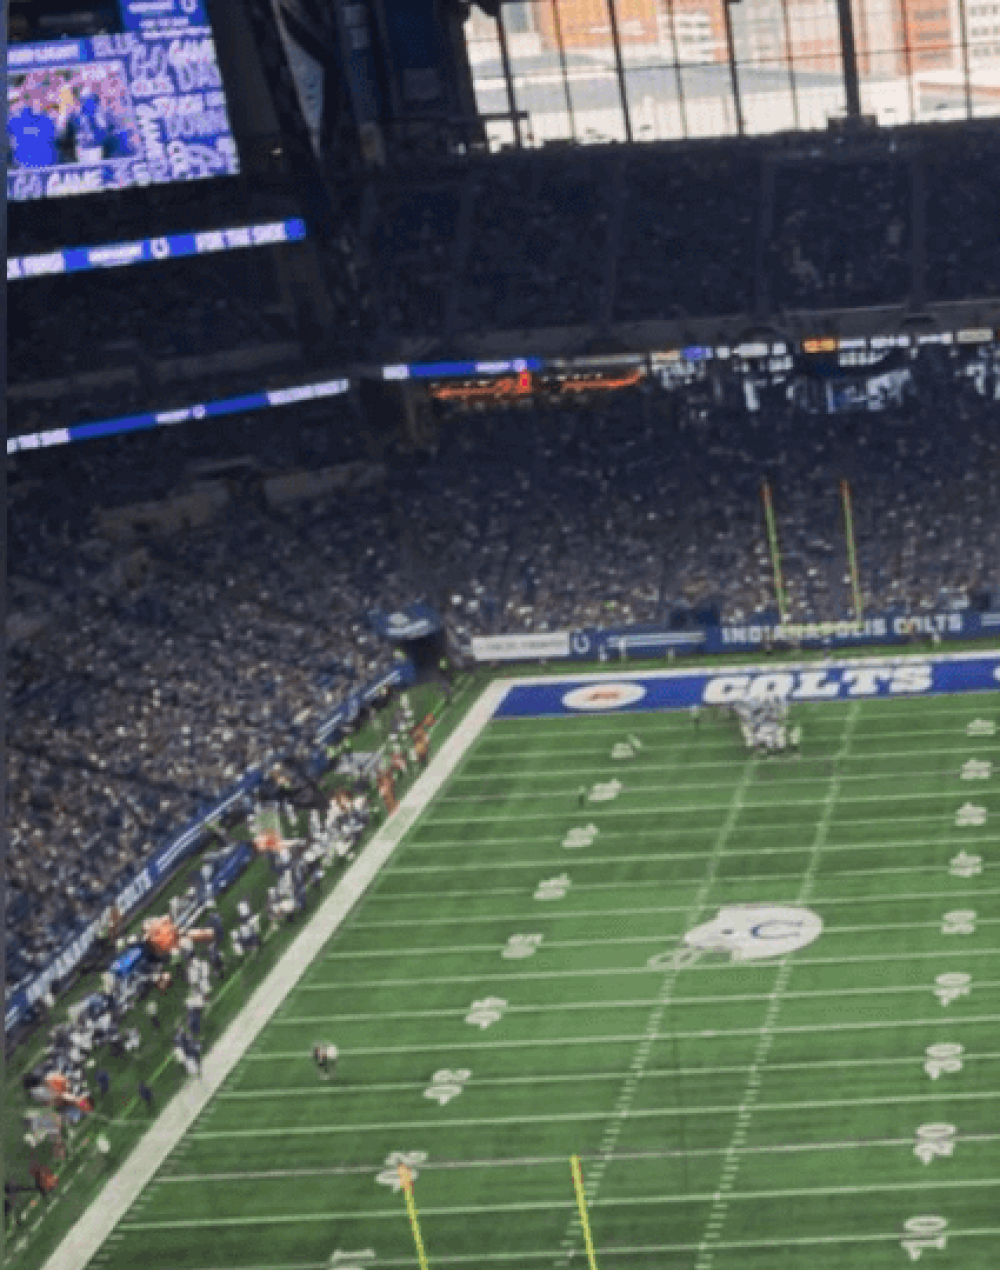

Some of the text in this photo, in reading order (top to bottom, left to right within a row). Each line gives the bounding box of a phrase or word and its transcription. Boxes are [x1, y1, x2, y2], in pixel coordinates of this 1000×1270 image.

[722, 618, 887, 644] INDAOLIS
[703, 665, 933, 704] COLTS
[913, 1122, 958, 1158] 20
[900, 1215, 949, 1252] 10
